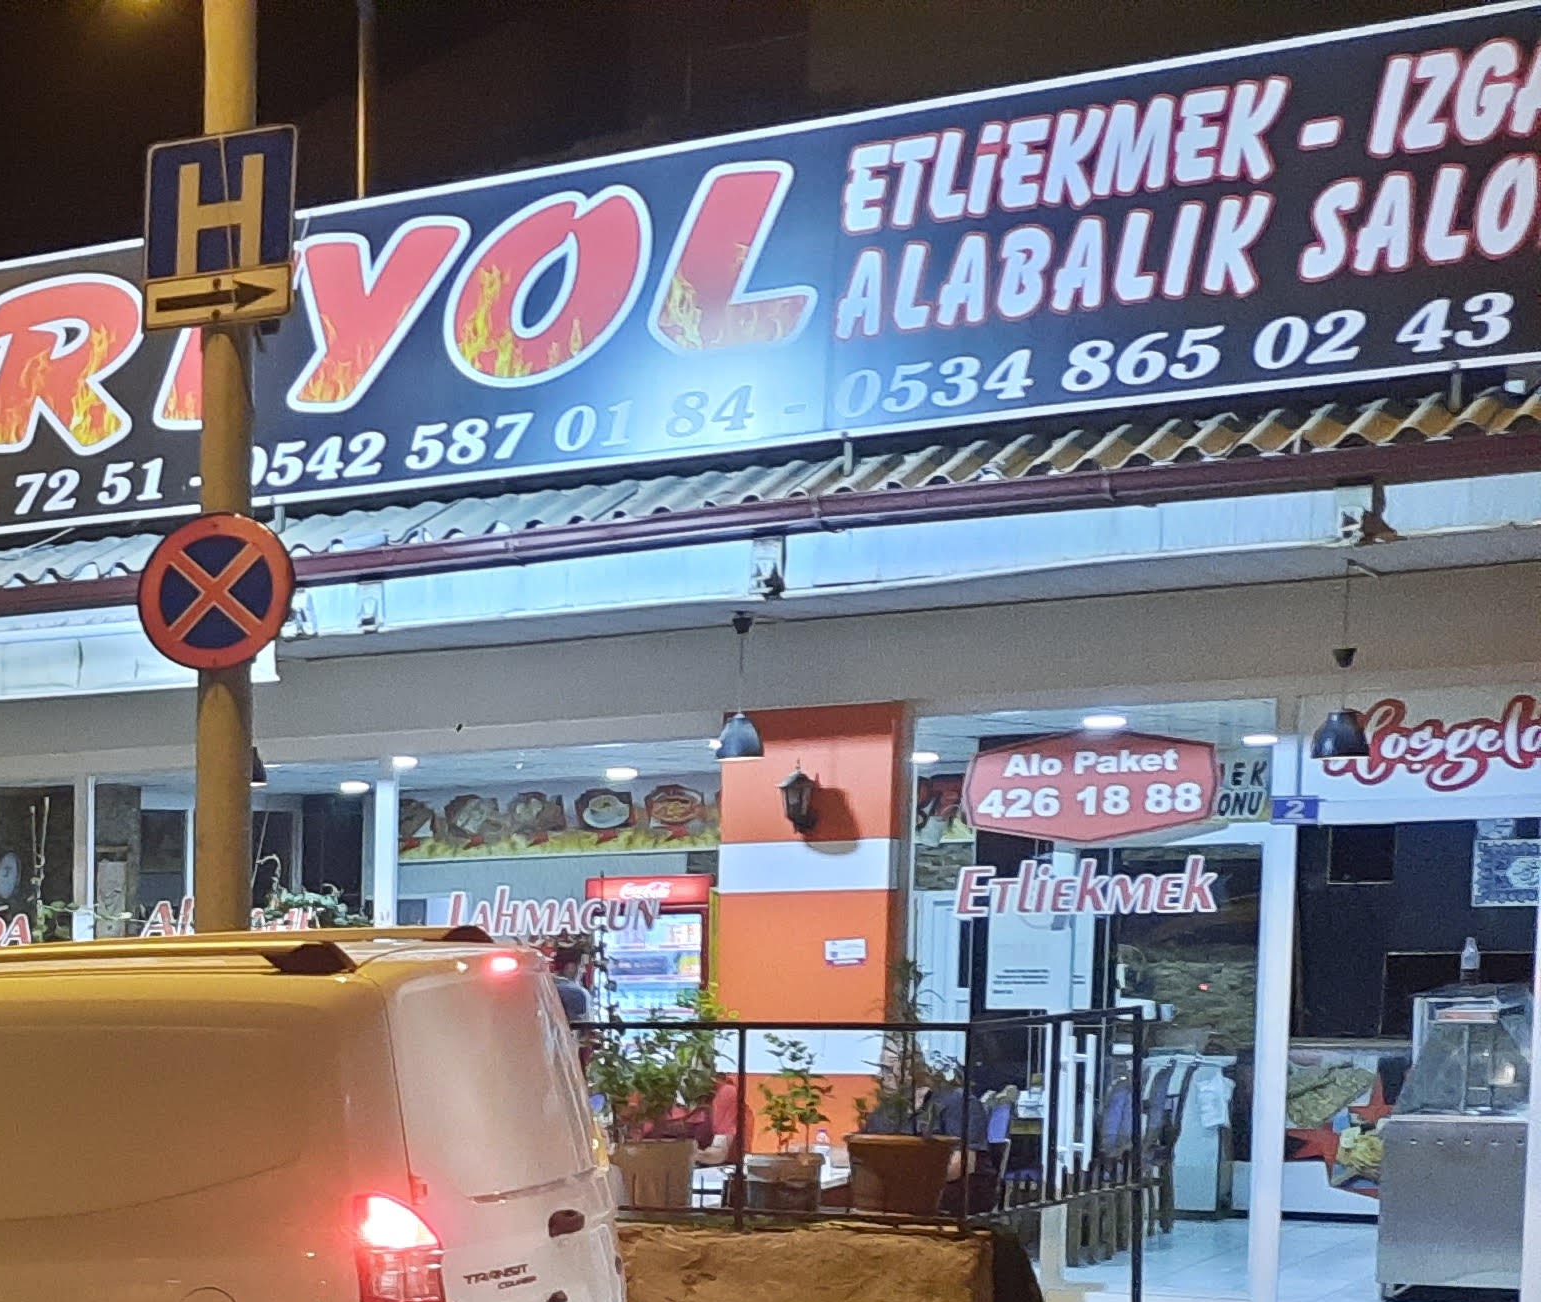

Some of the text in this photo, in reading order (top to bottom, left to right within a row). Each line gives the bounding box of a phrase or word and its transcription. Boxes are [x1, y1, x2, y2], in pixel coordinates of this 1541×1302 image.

[175, 153, 265, 276] H
[835, 193, 1271, 341] ALABALIK
[13, 466, 89, 516] 72
[98, 456, 165, 504] 51
[404, 411, 534, 471] 587
[554, 398, 630, 452] 01
[663, 384, 755, 438] 84
[838, 354, 1033, 420] 0534
[1064, 324, 1225, 386] 865
[1253, 308, 1369, 367] 02
[1395, 291, 1515, 354] 43
[1003, 748, 1179, 778] Alo Paket
[977, 782, 1202, 819] 426 18 88
[1284, 800, 1305, 819] 2
[463, 1264, 528, 1284] TRANSIT
